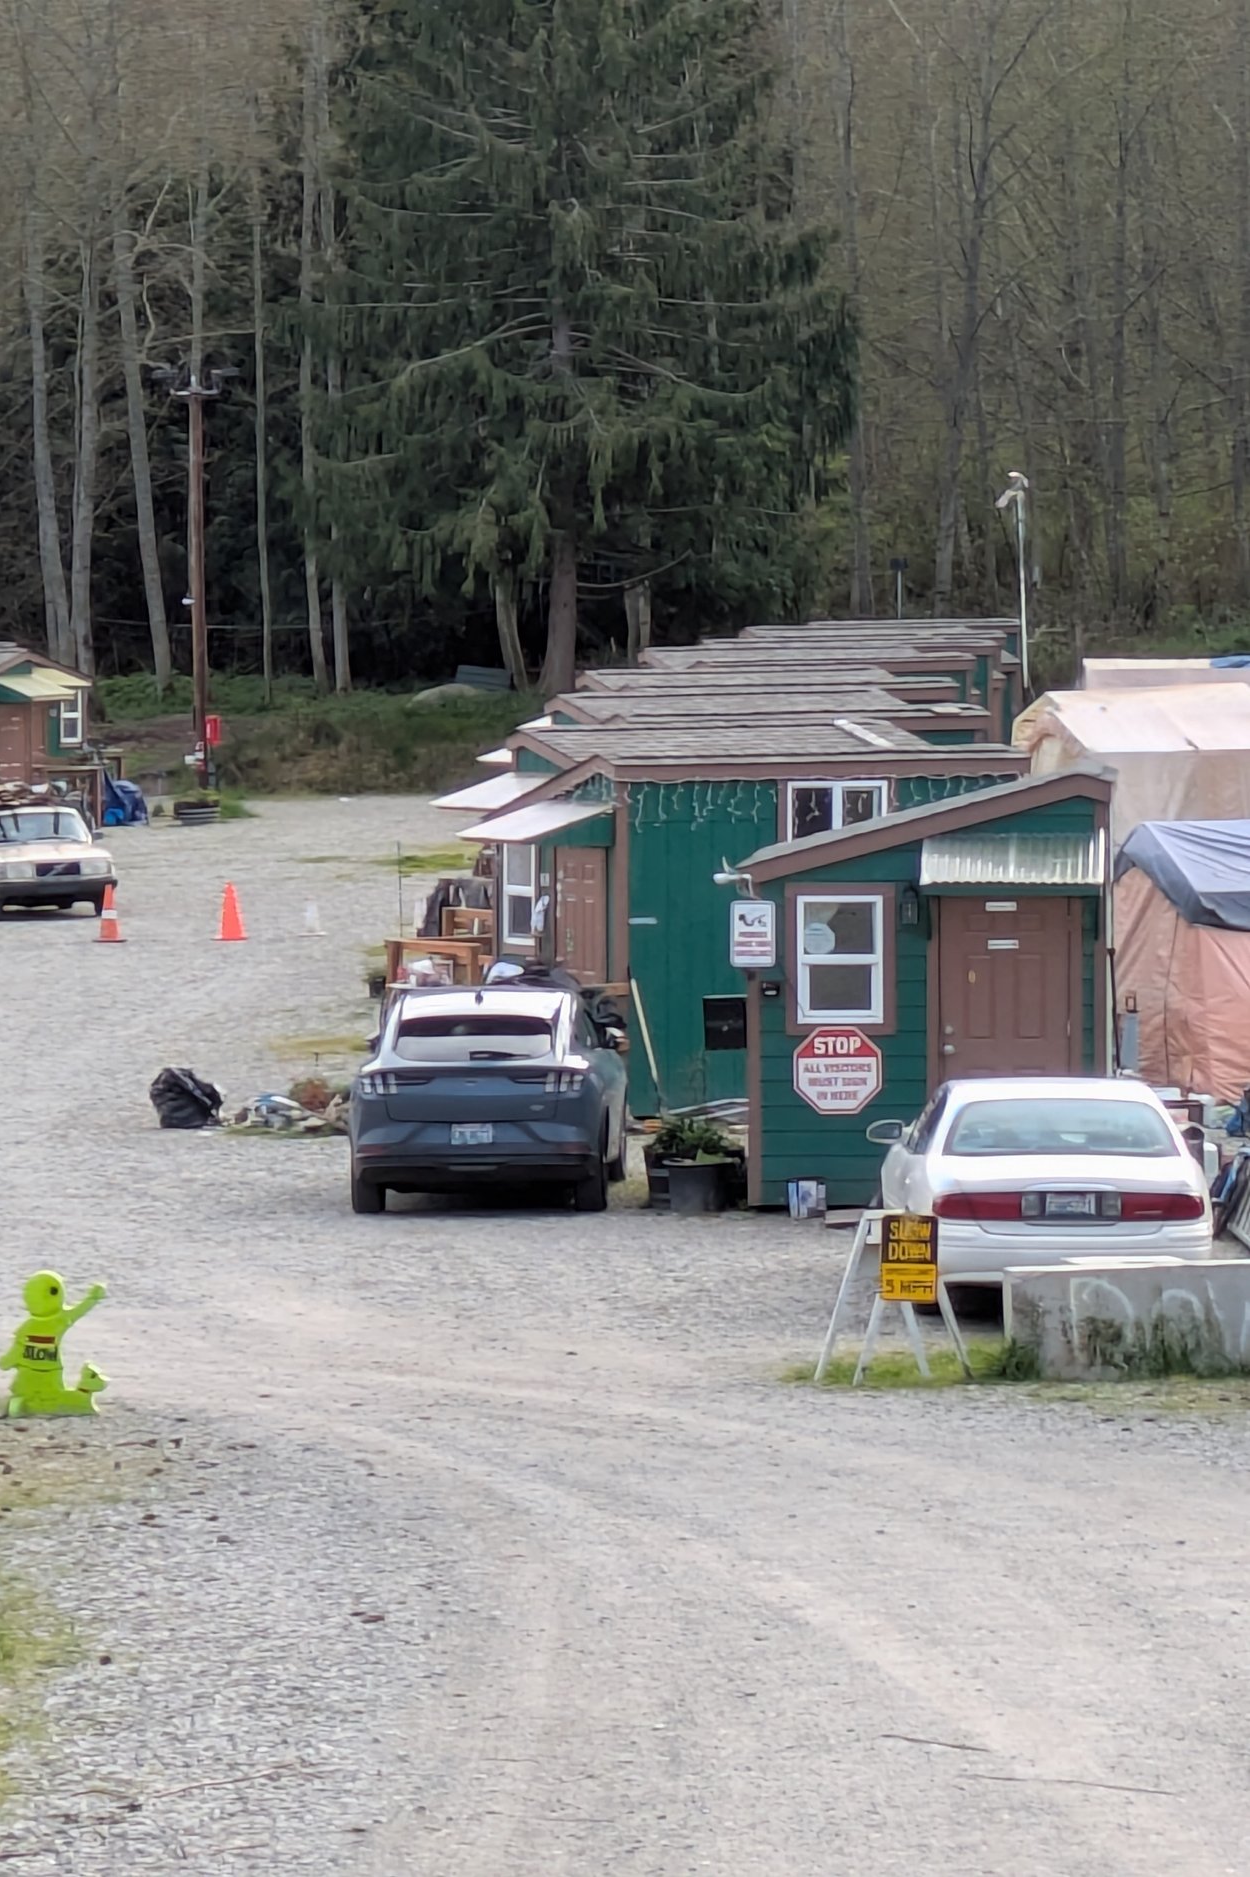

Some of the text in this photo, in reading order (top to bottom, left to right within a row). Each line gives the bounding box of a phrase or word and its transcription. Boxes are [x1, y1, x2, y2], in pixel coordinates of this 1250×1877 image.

[813, 1036, 862, 1055] STOP
[889, 1221, 931, 1240] SLOW
[888, 1242, 931, 1260] DOWN
[22, 1345, 58, 1361] SLOW
